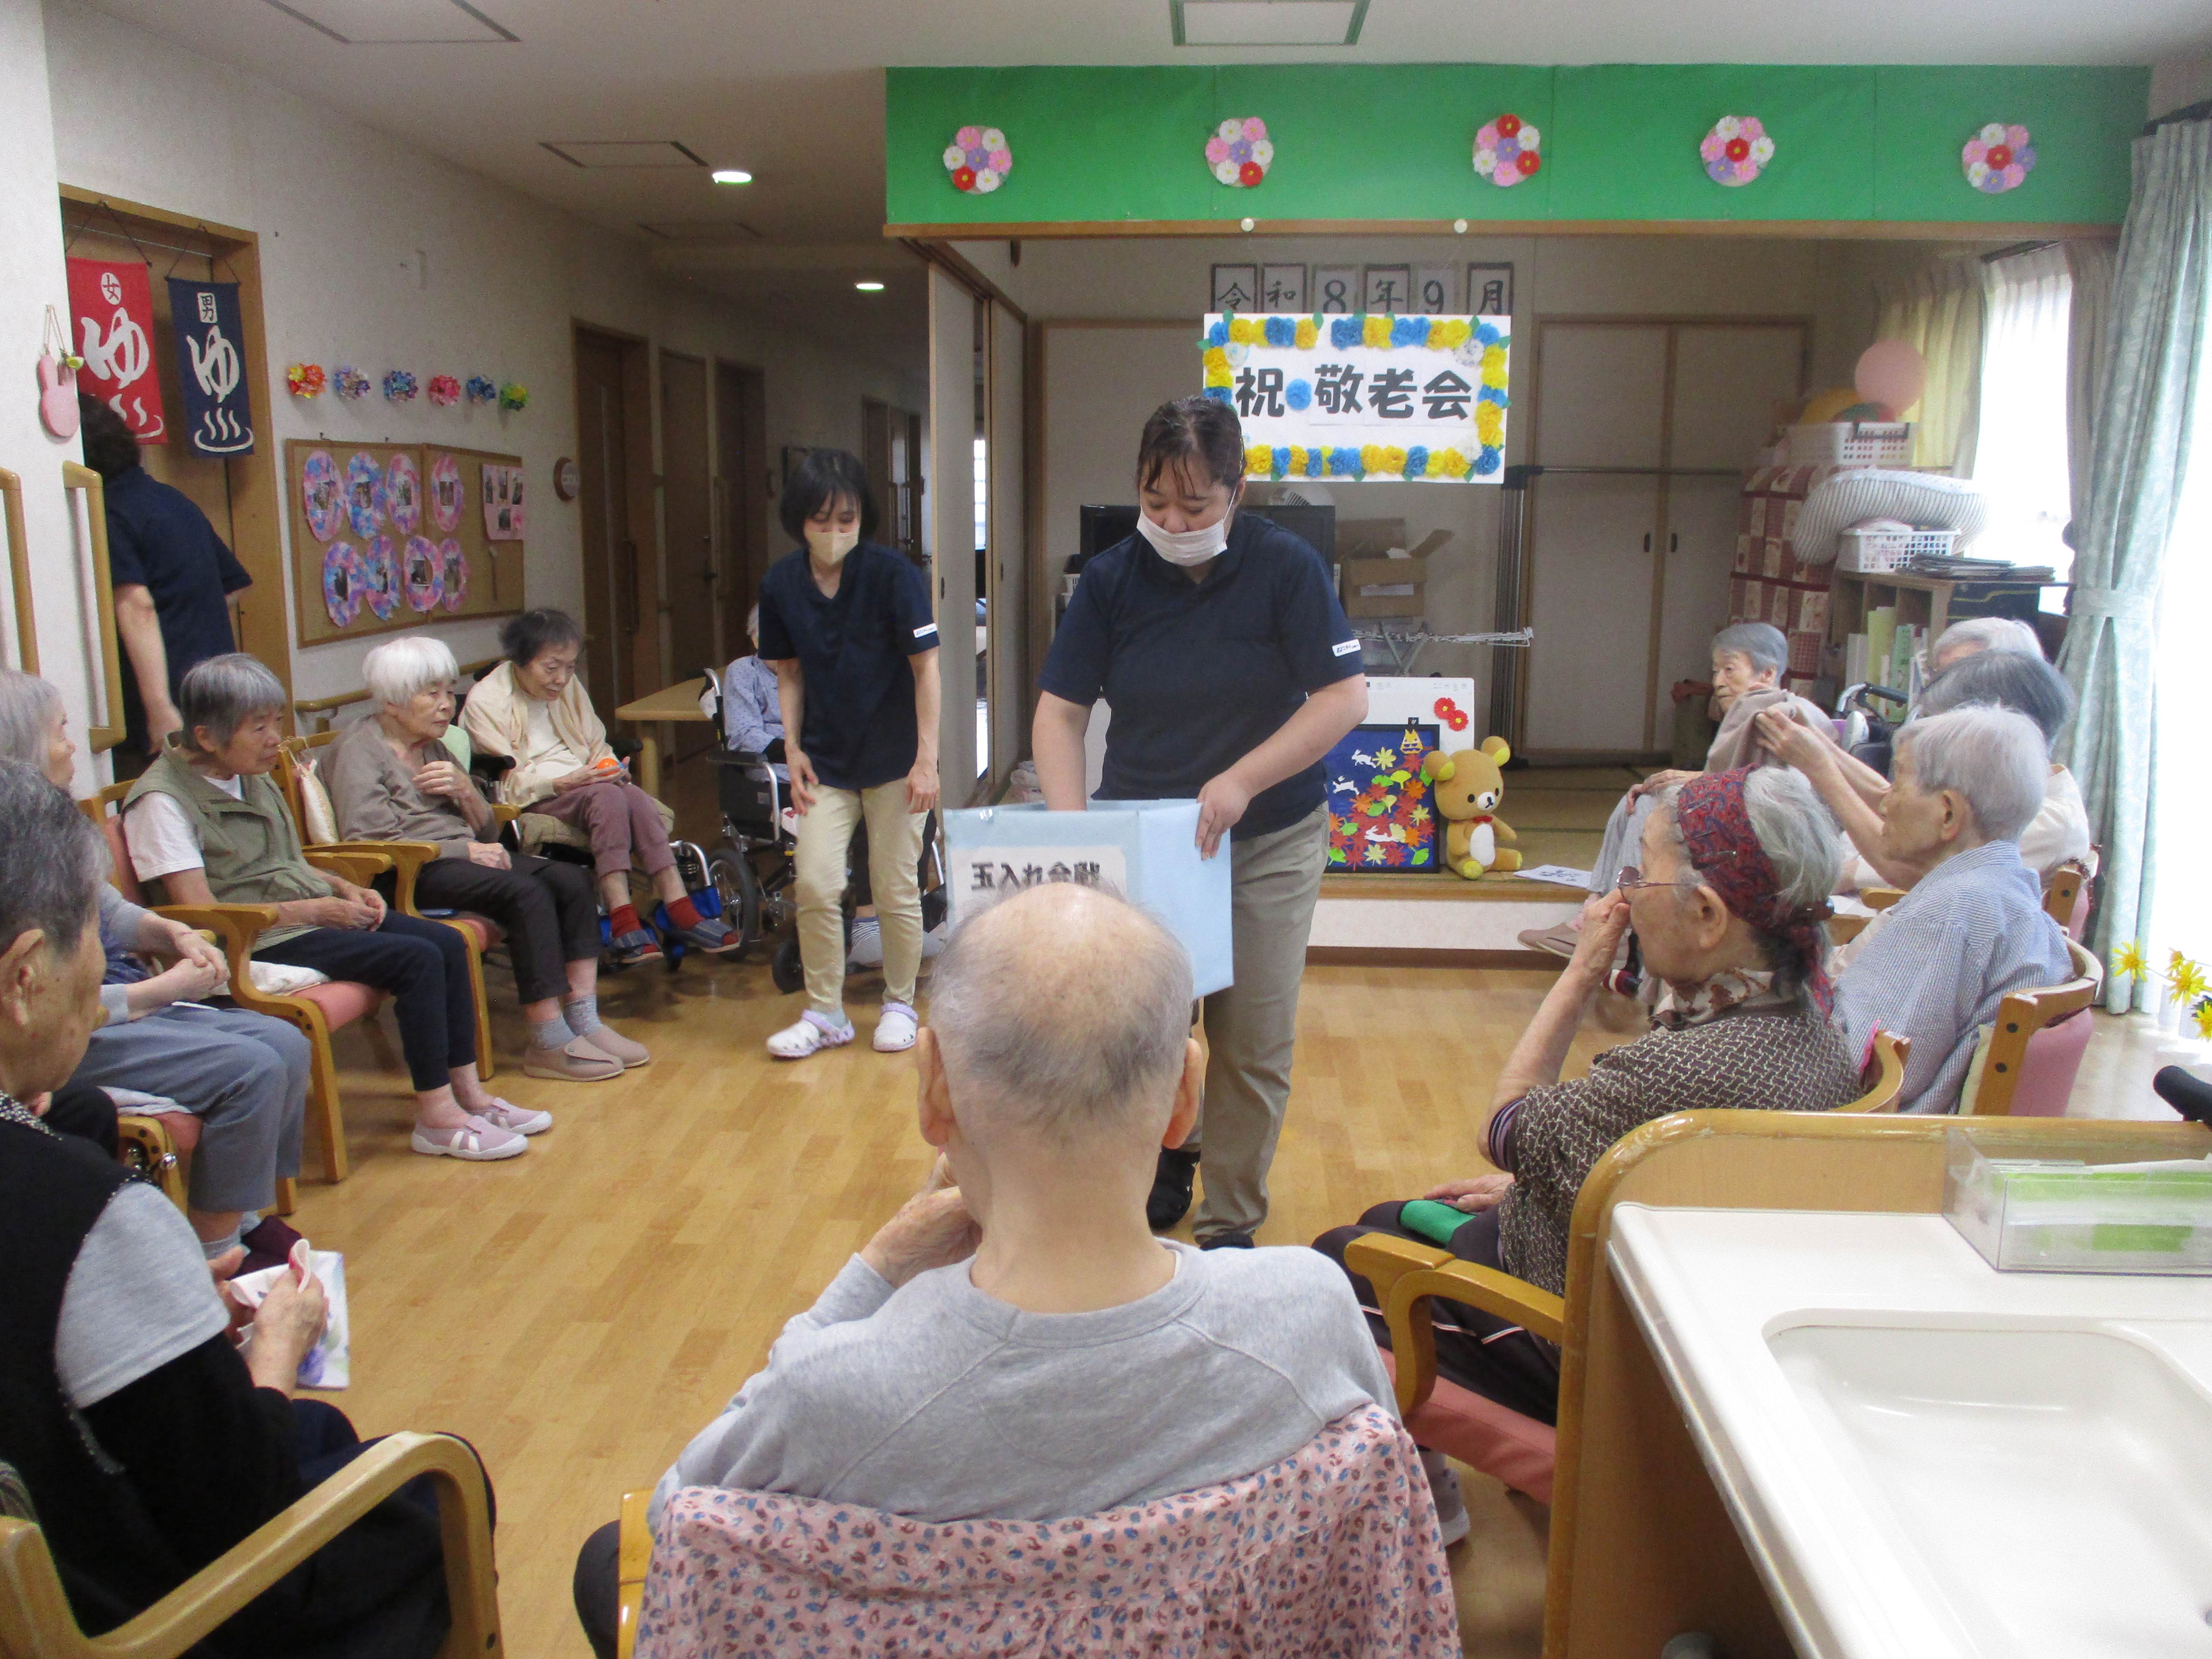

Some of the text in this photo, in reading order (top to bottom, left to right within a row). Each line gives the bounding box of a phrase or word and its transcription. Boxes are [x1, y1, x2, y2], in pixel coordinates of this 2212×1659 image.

[81, 273, 150, 389] 女 ゆ
[1217, 279, 1503, 313] 令和8年9月
[186, 295, 240, 403] 男 ゆ
[1235, 364, 1472, 421] 祝 敬老会
